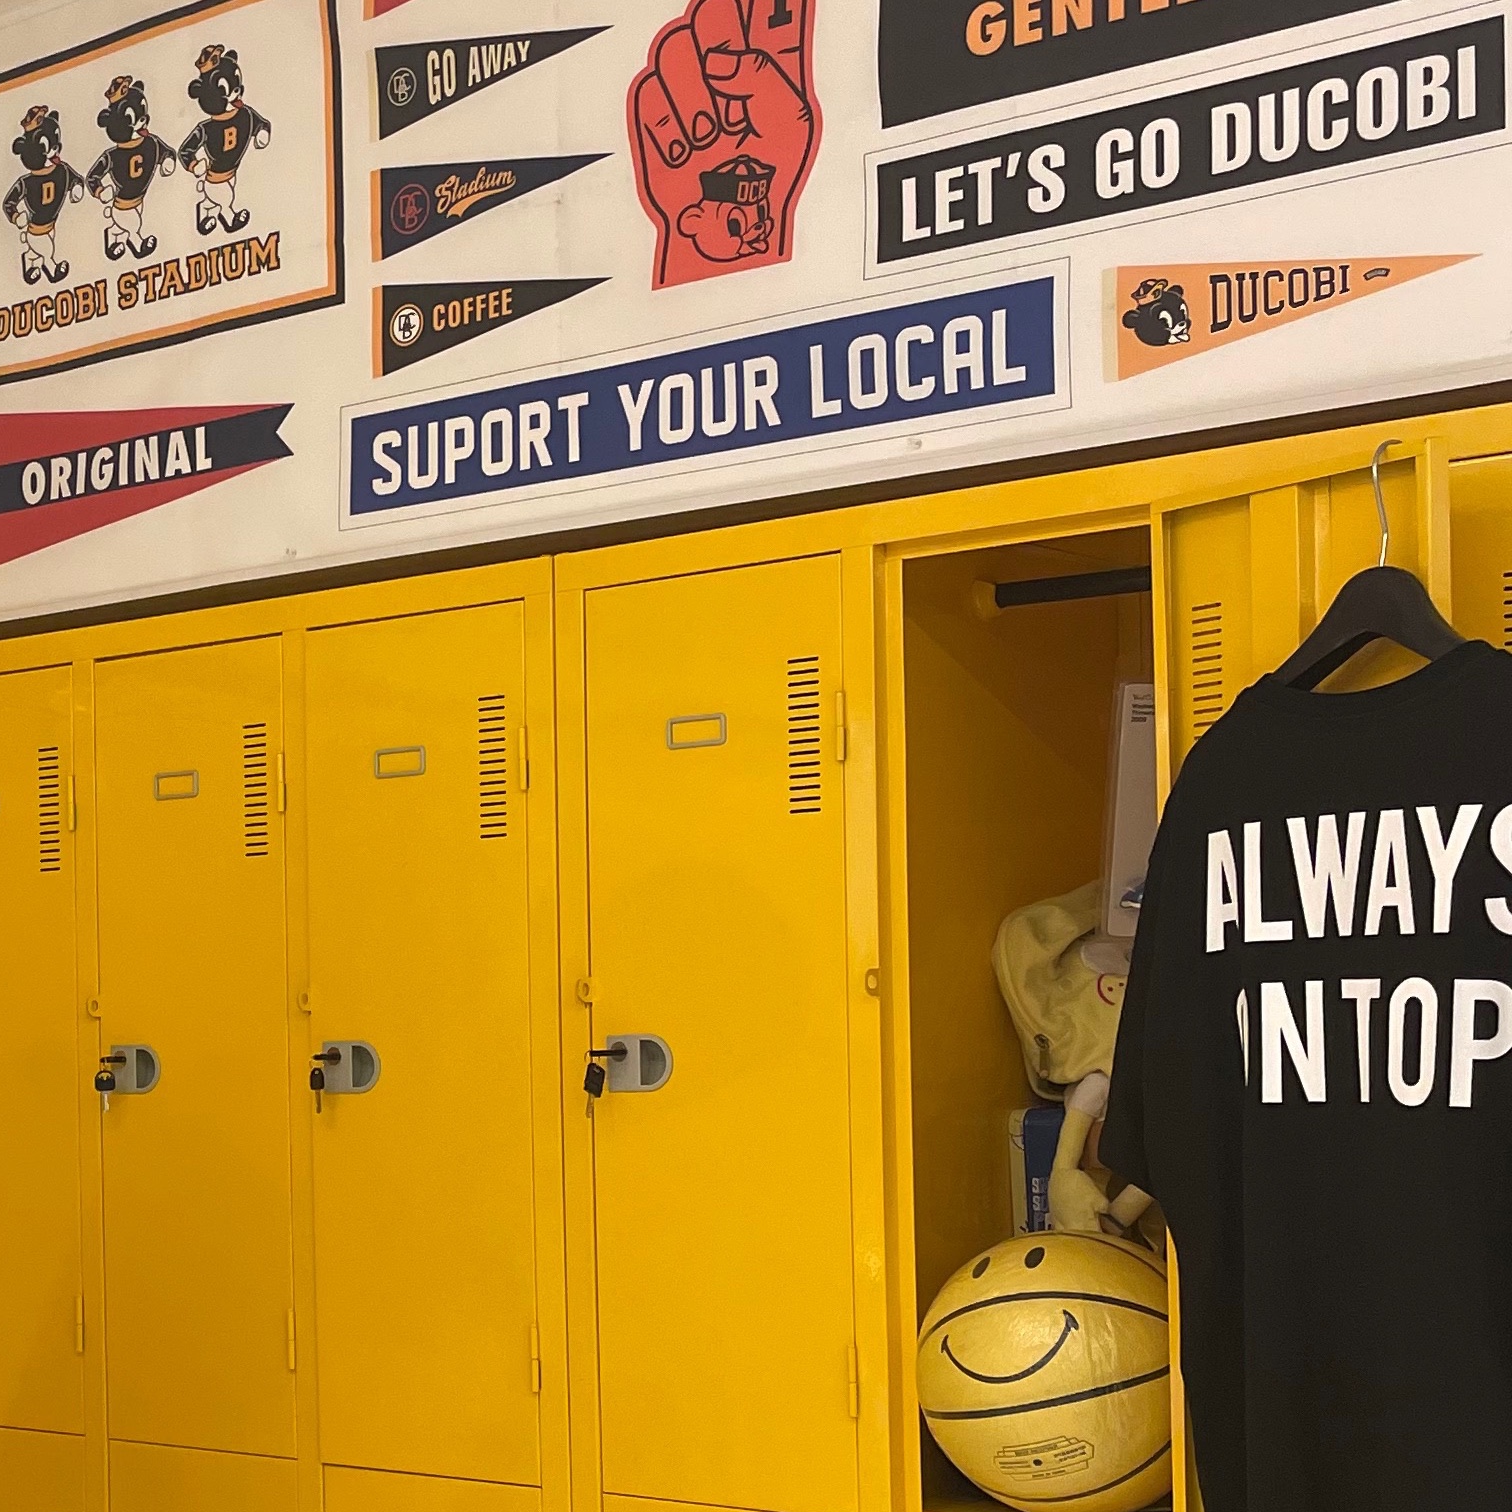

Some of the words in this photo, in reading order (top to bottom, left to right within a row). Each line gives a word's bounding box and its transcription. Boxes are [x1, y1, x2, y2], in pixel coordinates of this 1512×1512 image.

[426, 48, 457, 105] GO
[468, 40, 532, 87] AWAY
[41, 181, 56, 206] D
[128, 154, 144, 179] C
[222, 126, 238, 152] B
[900, 143, 1066, 243] LET'S
[1094, 117, 1180, 200] GO
[1210, 44, 1477, 176] DUCOBI
[434, 166, 517, 218] Stadium
[117, 231, 281, 312] STADIUM
[432, 288, 513, 331] COFFEE
[1209, 264, 1350, 333] DUCOBI
[370, 391, 590, 496] SUPORT
[618, 355, 783, 452] YOUR
[807, 308, 1029, 420] LOCAL
[21, 425, 213, 506] ORIGINAL
[1340, 976, 1512, 1108] TOP
